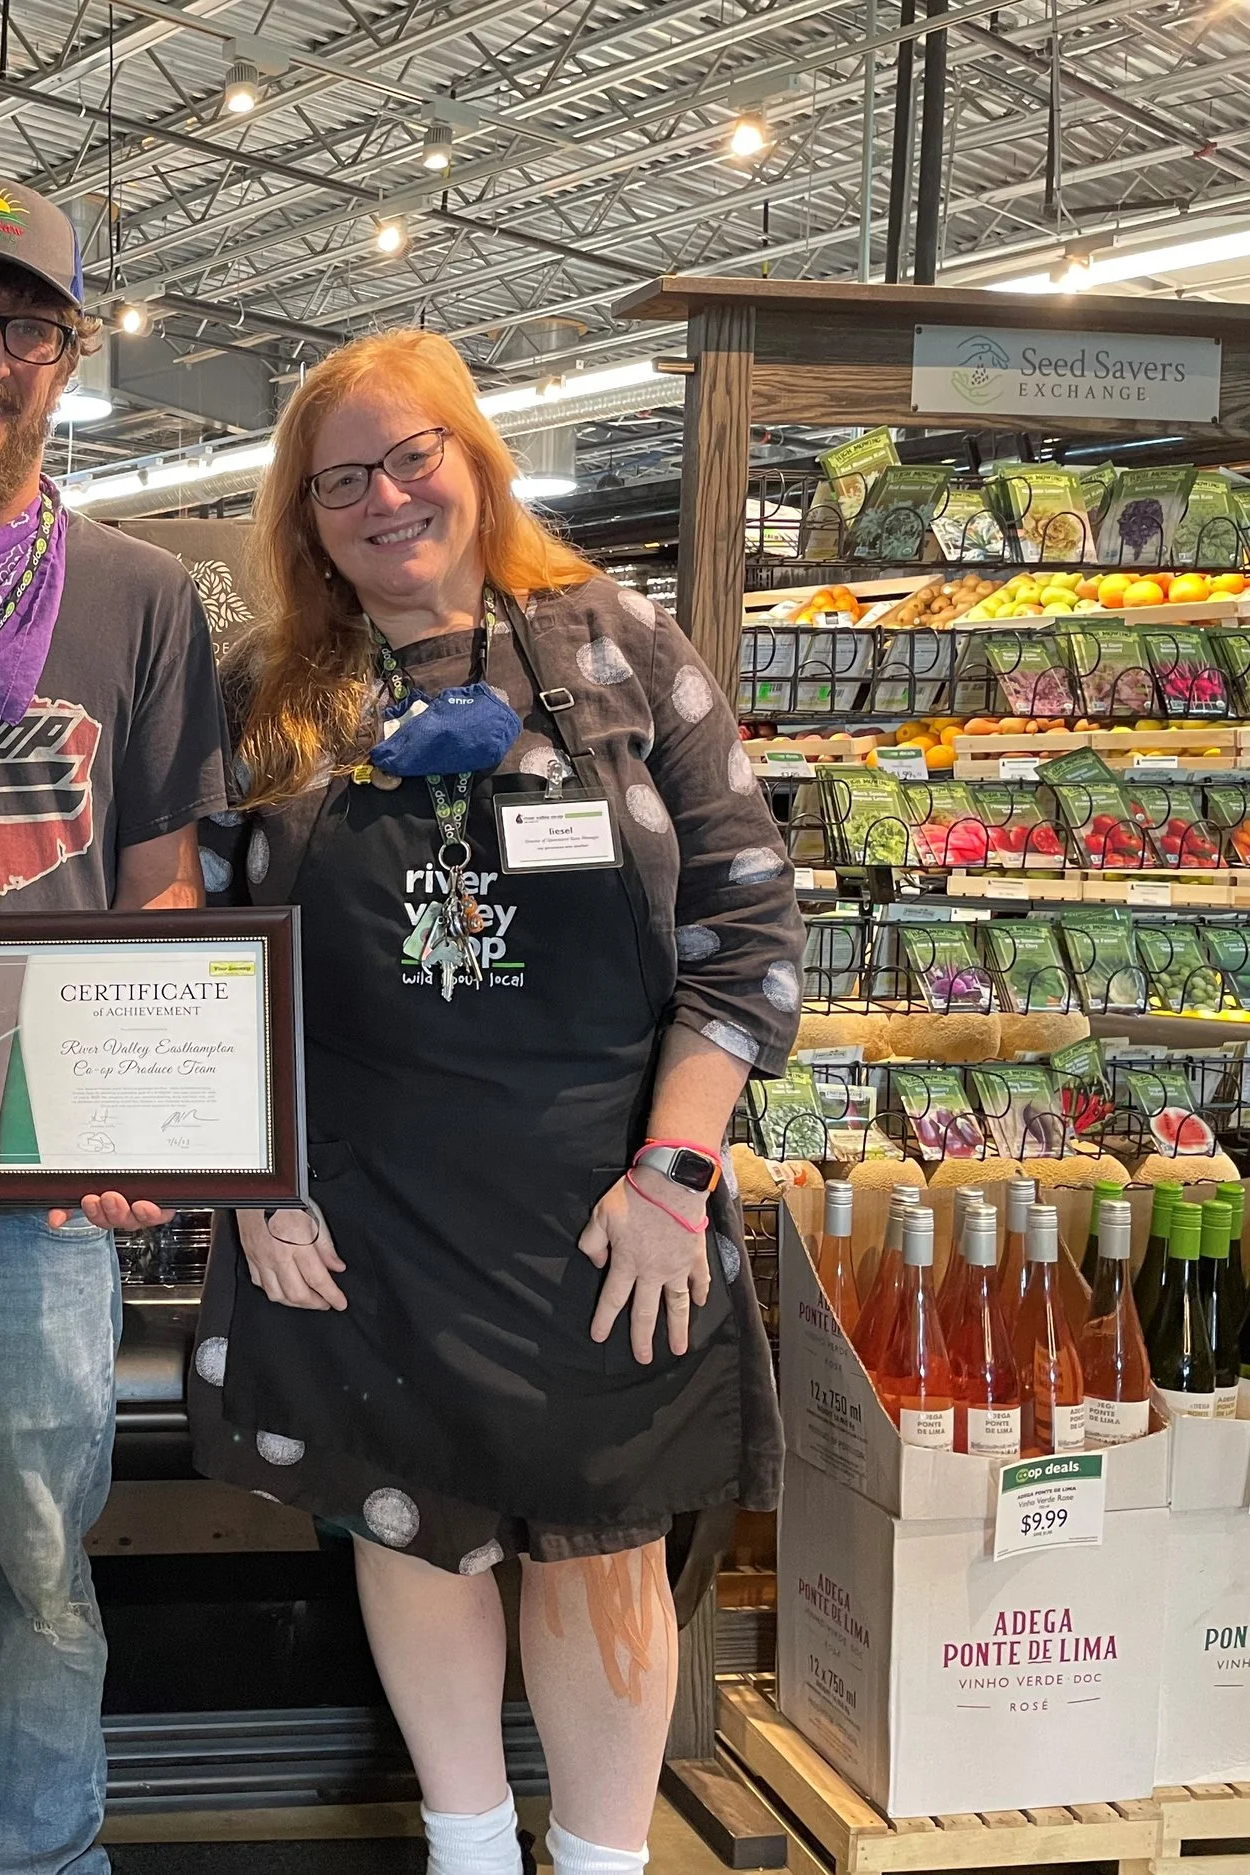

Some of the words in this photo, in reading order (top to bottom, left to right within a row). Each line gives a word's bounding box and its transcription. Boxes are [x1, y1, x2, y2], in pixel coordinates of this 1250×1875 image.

[1020, 347, 1085, 377] Seed
[1094, 350, 1186, 382] Savers
[1018, 382, 1147, 401] EXCHANGE
[448, 697, 474, 705] enro
[406, 862, 498, 896] river
[404, 902, 518, 937] vey
[490, 972, 524, 987] local
[60, 982, 229, 1002] CERTIFICATE
[93, 1007, 104, 1017] of
[106, 1006, 202, 1016] ACHIEVEMENT
[60, 1040, 98, 1055] River
[103, 1038, 150, 1058] Valley
[155, 1038, 235, 1058] Easthampton
[73, 1060, 114, 1079] Co-op
[118, 1060, 173, 1075] Produce
[177, 1060, 217, 1075] Team
[850, 1403, 862, 1422] ml
[1089, 1408, 1115, 1417] PONTE
[1045, 1461, 1080, 1475] deals
[1018, 1500, 1035, 1508] Vinho
[1036, 1496, 1056, 1504] Verde
[1057, 1494, 1074, 1502] Rose
[1021, 1509, 1068, 1536] $9.99
[817, 1573, 850, 1612] ADEGA
[798, 1577, 829, 1616] PONTE
[844, 1613, 869, 1648] LIMA
[993, 1608, 1073, 1636] ADEGA
[943, 1641, 1021, 1668] PONTE
[1028, 1639, 1053, 1664] DE
[1059, 1635, 1118, 1663] LIMA
[958, 1677, 1010, 1689] VINHO
[1016, 1674, 1064, 1687] VERDE
[1074, 1673, 1102, 1684] DOC
[846, 1690, 856, 1709] ml
[1009, 1698, 1049, 1712] ROSÉ
